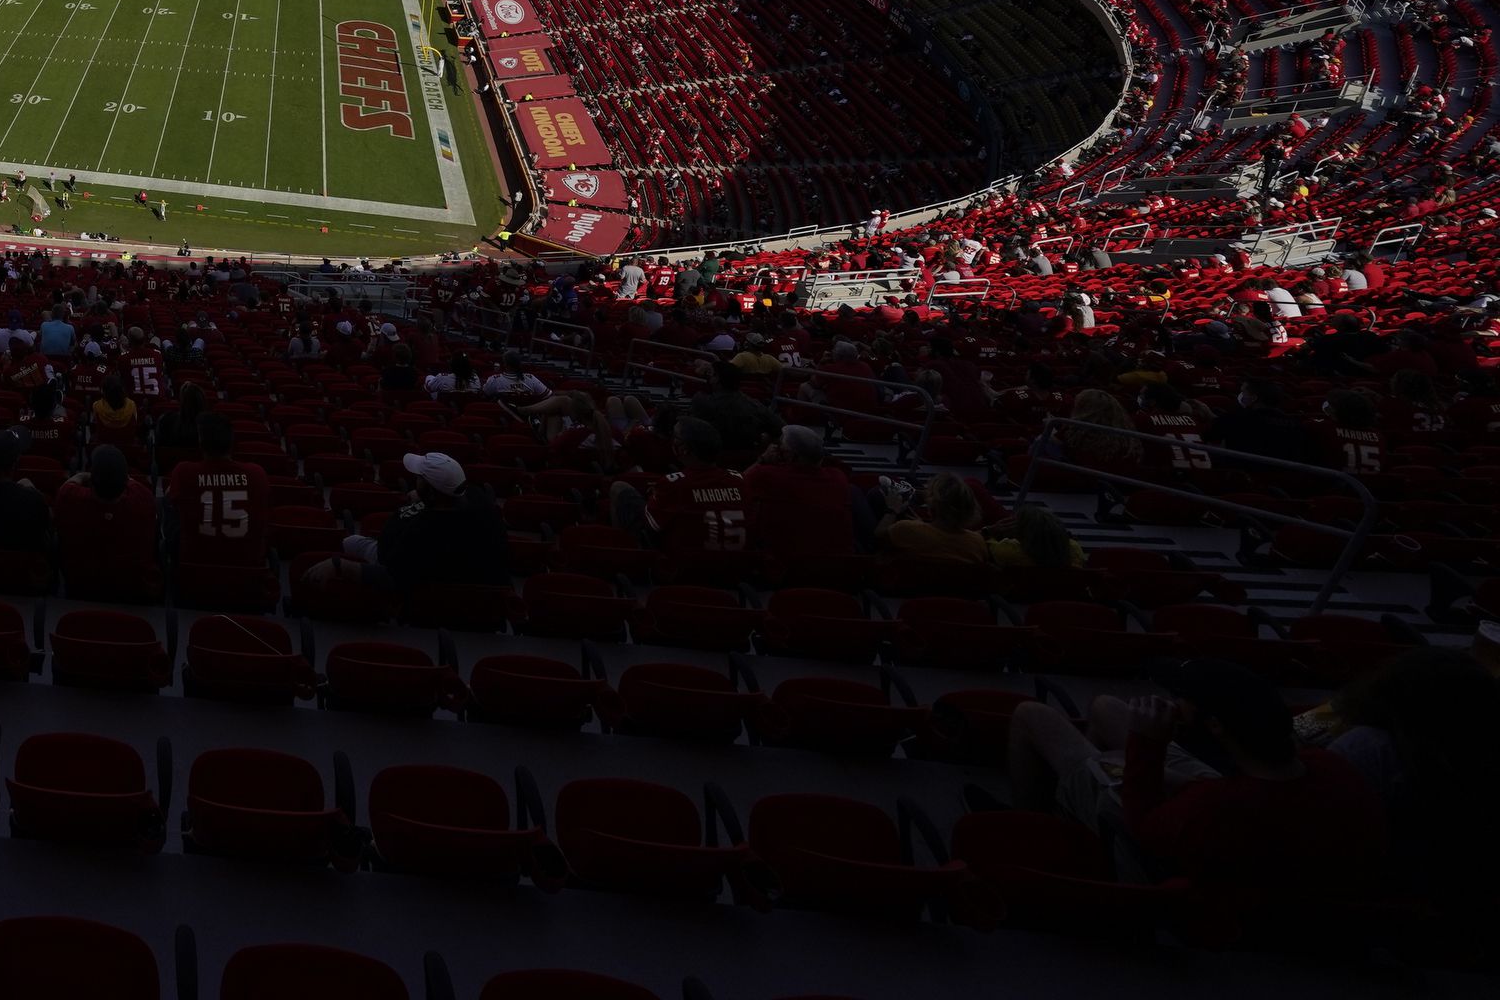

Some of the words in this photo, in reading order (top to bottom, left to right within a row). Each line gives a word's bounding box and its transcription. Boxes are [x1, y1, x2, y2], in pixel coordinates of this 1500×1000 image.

[518, 48, 546, 72] VOTE
[336, 20, 416, 140] CHIEFS
[9, 93, 43, 106] 30
[423, 79, 445, 111] CATCH
[102, 101, 137, 114] 20
[201, 110, 238, 123] 10
[529, 106, 568, 158] KINGDOM
[555, 112, 586, 146] CHIEFS
[147, 280, 157, 291] 10
[130, 357, 155, 366] MAHOMES
[131, 367, 160, 396] 15
[1150, 413, 1195, 428] MAHOMES
[1336, 427, 1380, 442] MAHOMES
[1171, 432, 1212, 471] 15
[1342, 442, 1382, 476] 15
[199, 472, 248, 488] MAHOMES
[690, 487, 743, 504] MAHOMES
[198, 490, 250, 539] 15
[703, 510, 747, 552] 15
